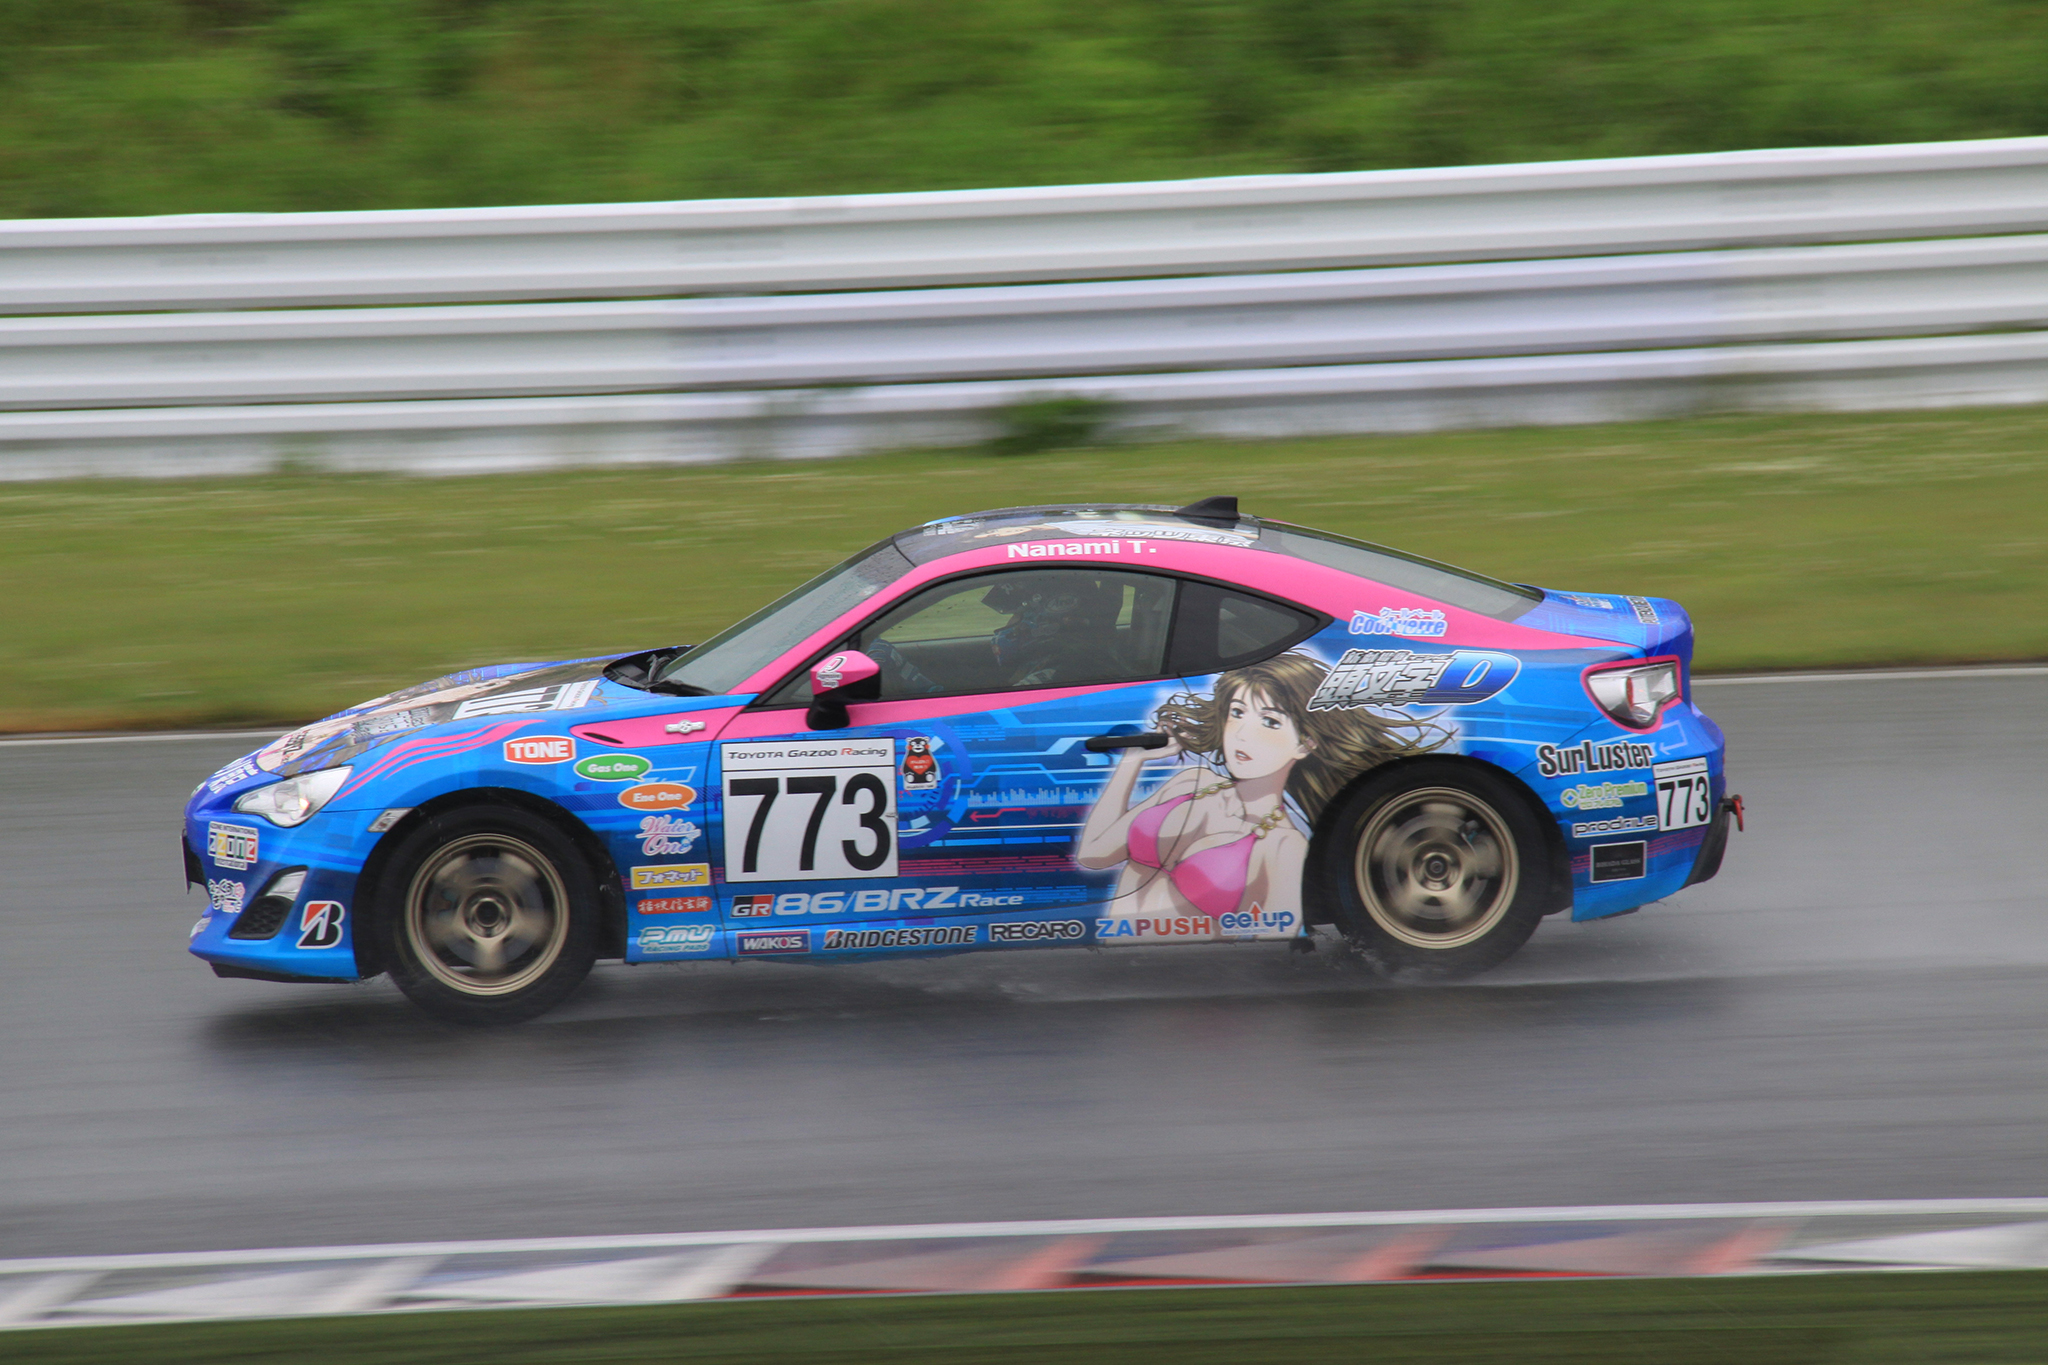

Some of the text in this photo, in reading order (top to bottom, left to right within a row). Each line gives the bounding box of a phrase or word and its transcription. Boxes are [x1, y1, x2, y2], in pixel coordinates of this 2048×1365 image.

[1007, 540, 1157, 558] Nanami T.
[510, 741, 569, 759] TONE
[728, 748, 888, 760] TOYOTA GAZOO Racing
[1536, 740, 1654, 777] SurLuster
[587, 762, 639, 773] Gas One
[632, 791, 683, 802] Ene One
[1576, 784, 1603, 799] Zero
[1658, 776, 1709, 827] 773
[729, 773, 891, 873] 773
[959, 893, 1024, 908] Race
[731, 903, 771, 917] GR
[988, 920, 1086, 941] RECARO
[1095, 916, 1212, 938] ZAPUSH
[822, 925, 978, 949] BRIDGESTONE
